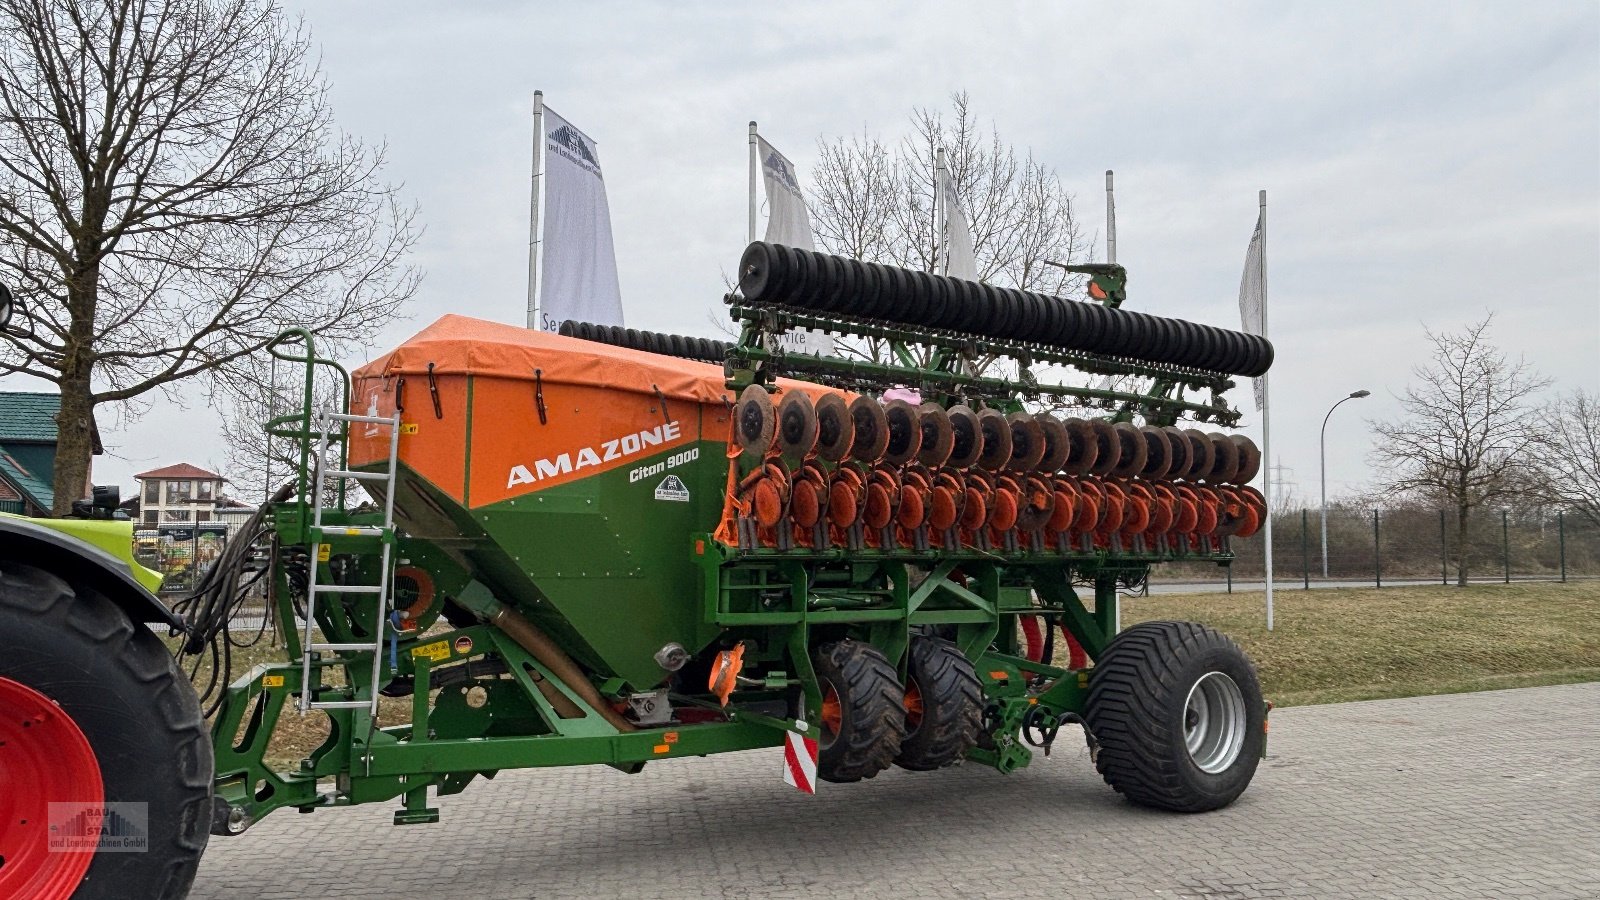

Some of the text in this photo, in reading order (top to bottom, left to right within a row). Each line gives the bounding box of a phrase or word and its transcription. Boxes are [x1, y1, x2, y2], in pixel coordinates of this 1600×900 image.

[507, 421, 681, 489] AMAZONE
[630, 461, 665, 483] Citan
[667, 448, 699, 470] 9000
